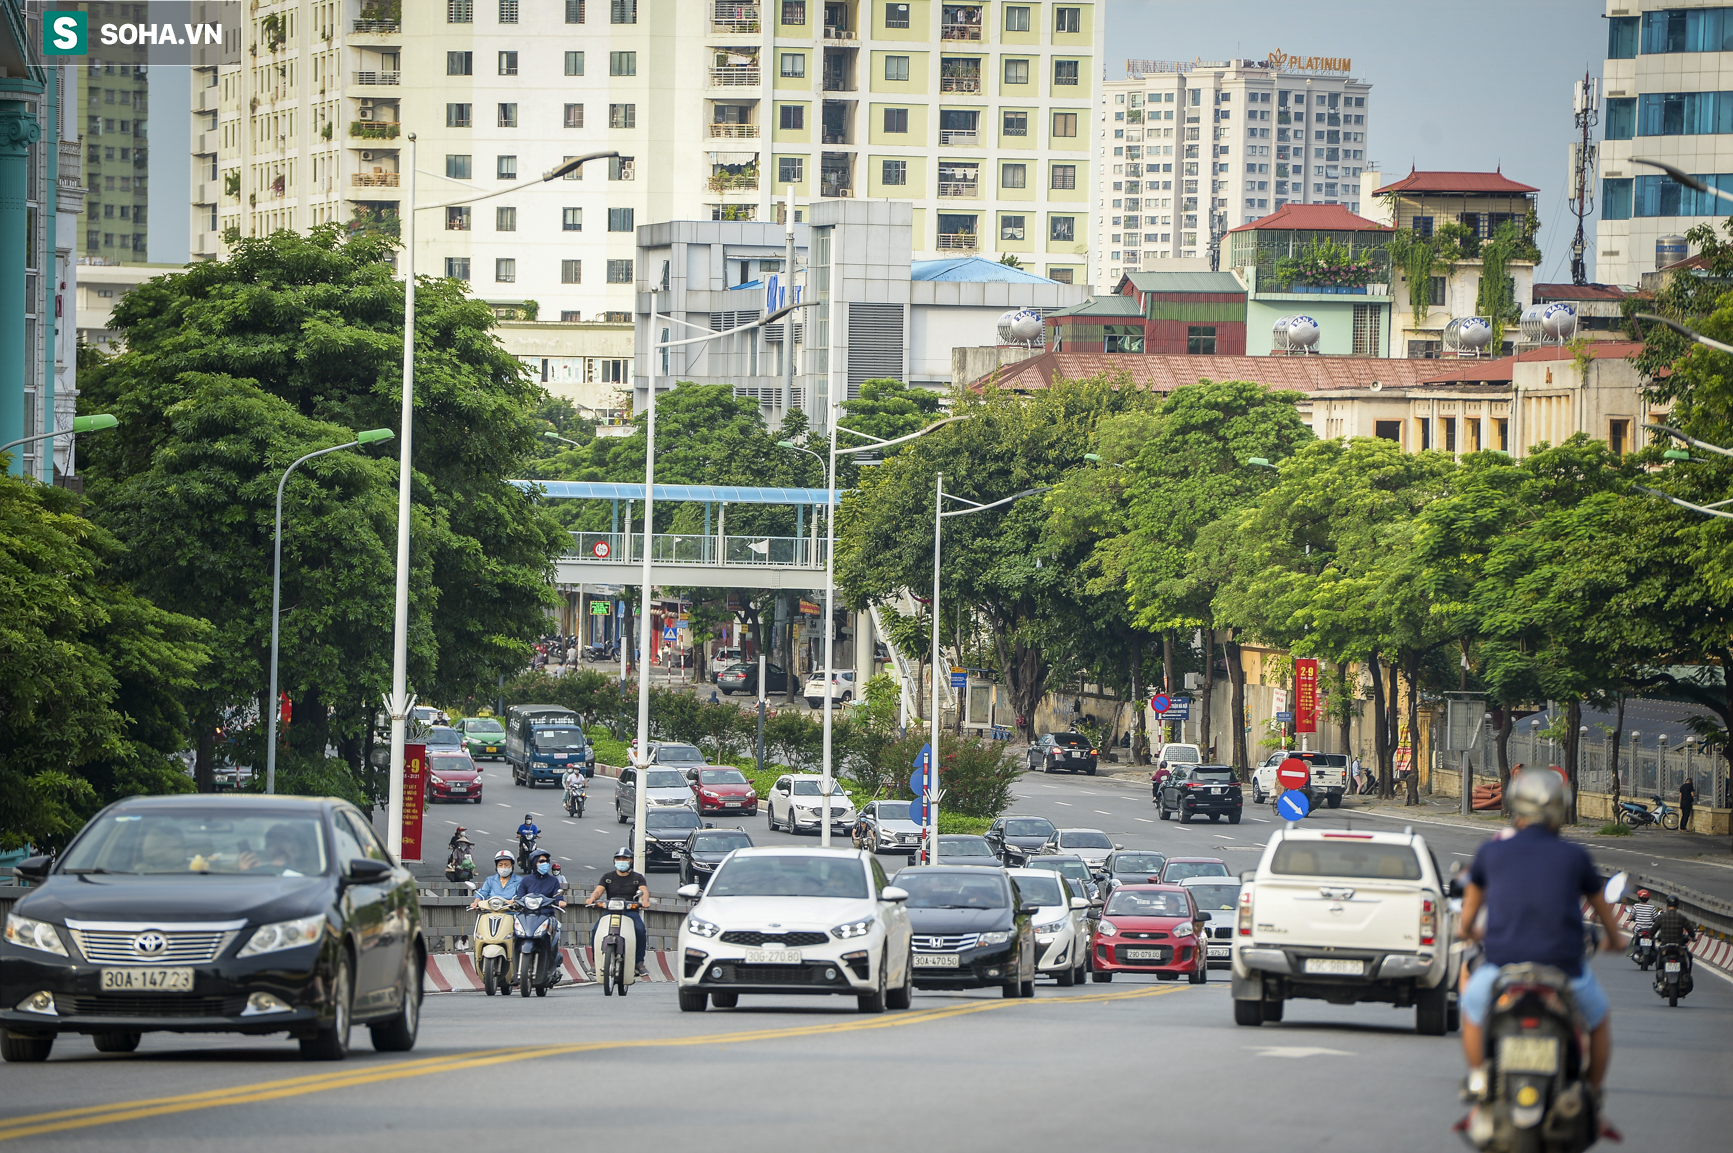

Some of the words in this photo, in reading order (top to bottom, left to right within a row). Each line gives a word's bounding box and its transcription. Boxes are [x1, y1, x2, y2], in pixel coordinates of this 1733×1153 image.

[1289, 56, 1351, 71] PLATINUM
[1015, 311, 1038, 321] TANA
[528, 715, 546, 724] THẾ
